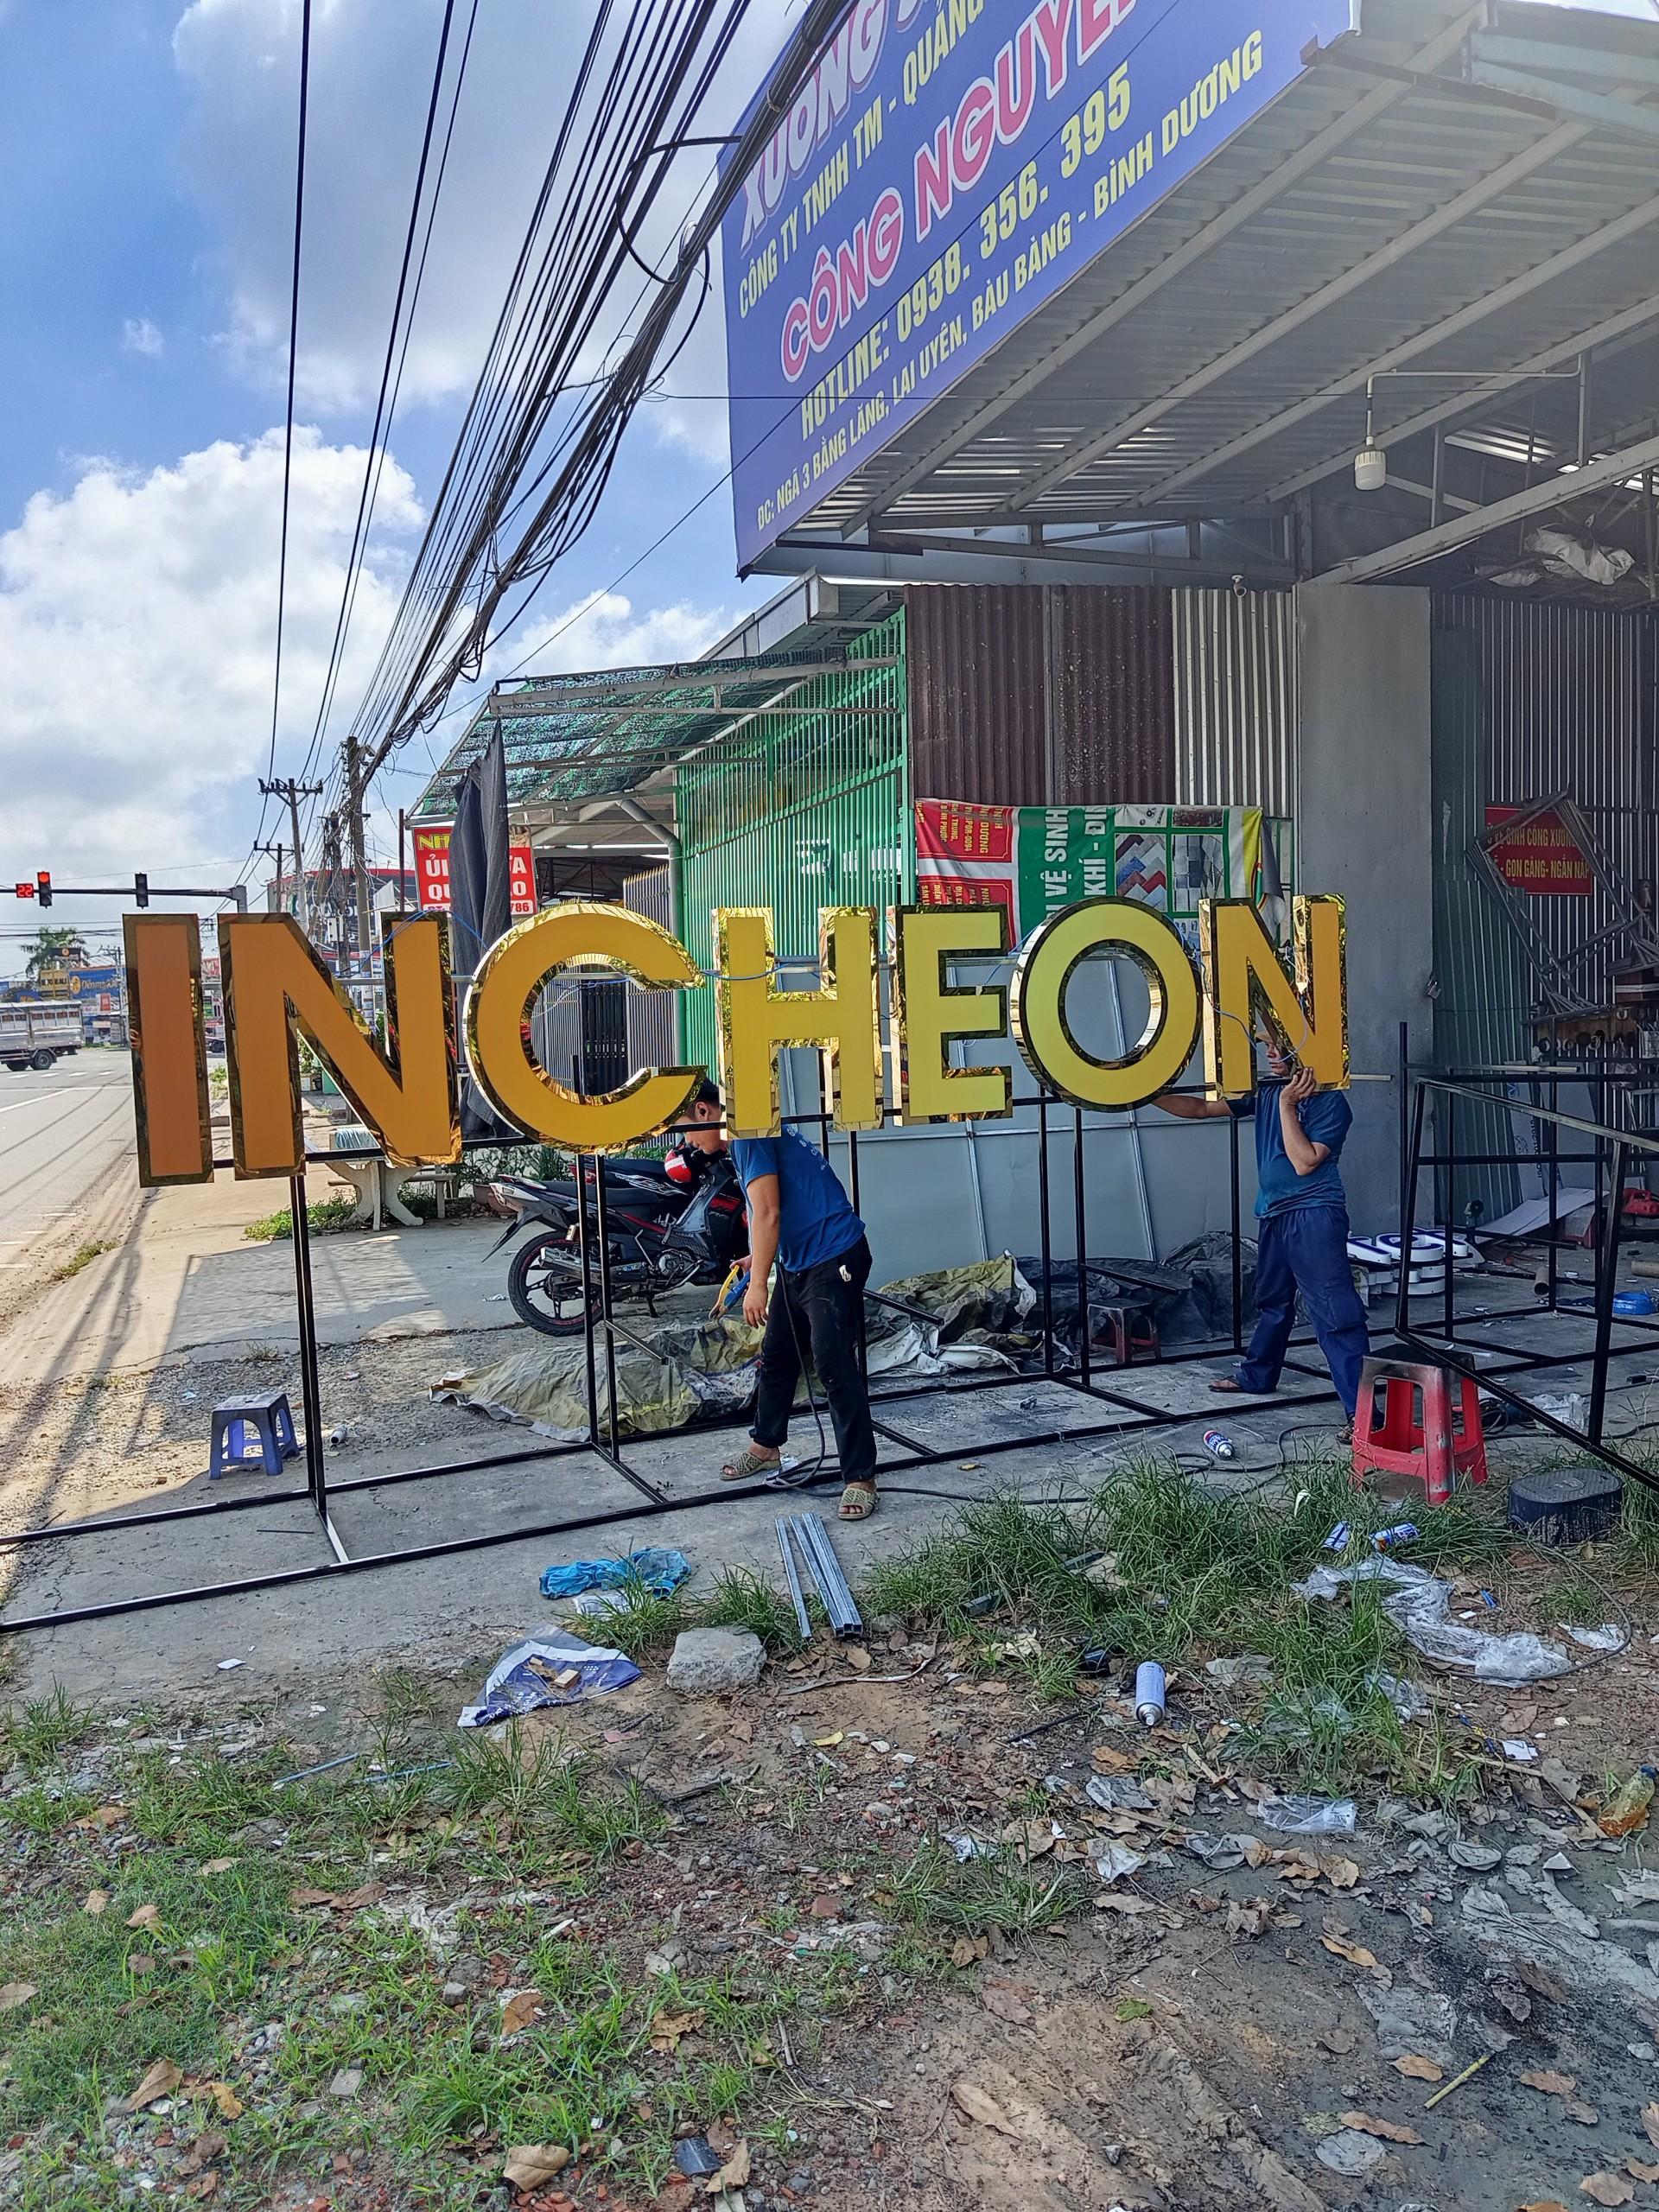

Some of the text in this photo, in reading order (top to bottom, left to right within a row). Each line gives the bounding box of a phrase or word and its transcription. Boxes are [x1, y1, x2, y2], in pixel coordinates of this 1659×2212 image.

[739, 238, 778, 319] CÔNG
[780, 205, 799, 265] TY
[802, 140, 849, 235] TNHH
[853, 94, 883, 170] TM
[776, 467, 800, 514] NGÃ
[802, 462, 810, 490] 3
[849, 391, 890, 448] LĂNG,
[893, 359, 916, 406] LAI
[918, 314, 968, 379] UYÊN,
[1093, 130, 1154, 219] BÌNH
[1161, 29, 1263, 158] DƯƠNG
[780, 187, 904, 383] CÔNG
[800, 60, 1130, 441] HOTLINE: 0938. 356. 395
[17, 884, 34, 898] 22
[1039, 869, 1072, 898] VỆ
[1044, 809, 1070, 862] SINH
[123, 893, 1351, 1186] INCHEON
